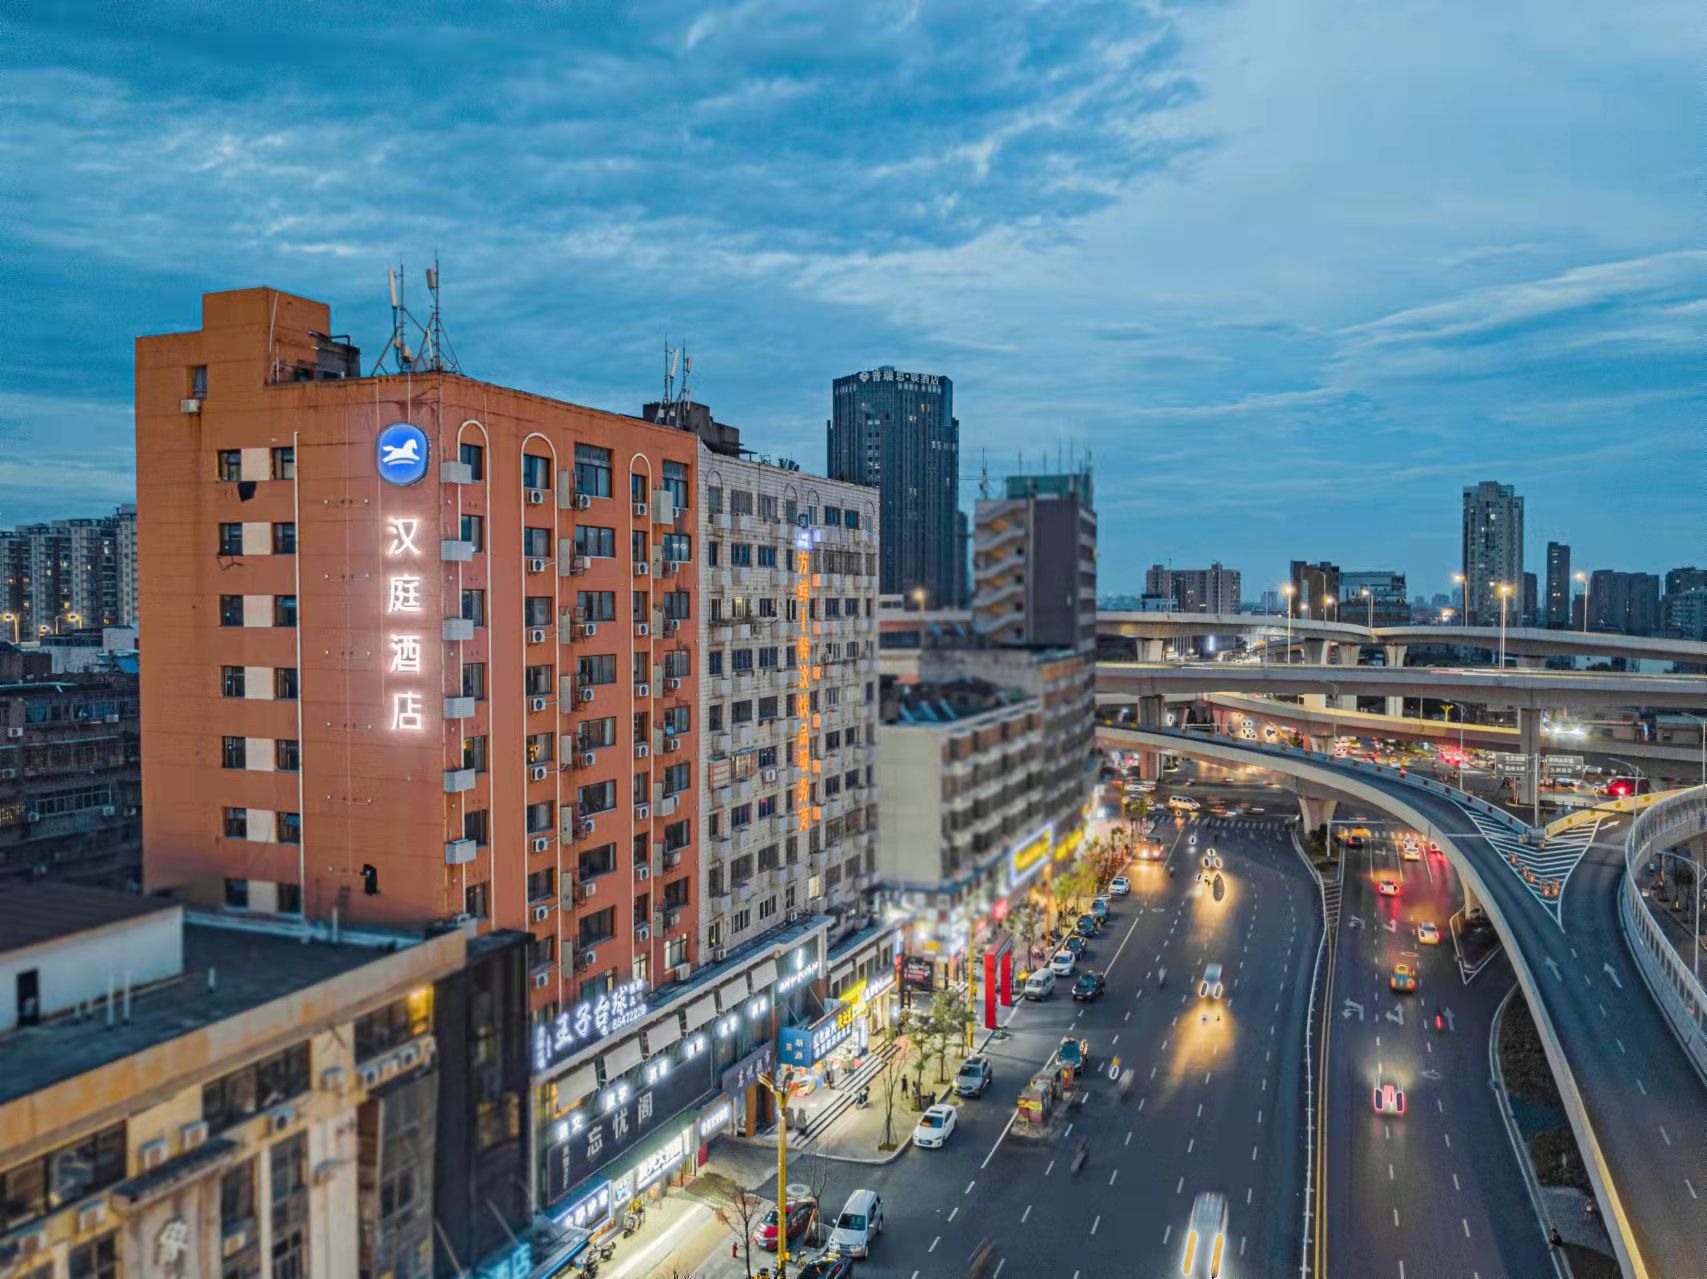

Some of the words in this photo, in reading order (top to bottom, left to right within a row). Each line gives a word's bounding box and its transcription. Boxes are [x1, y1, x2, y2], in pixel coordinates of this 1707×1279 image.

[388, 518, 424, 730] 汉庭酒店
[586, 1091, 653, 1157] 忘忧阁
